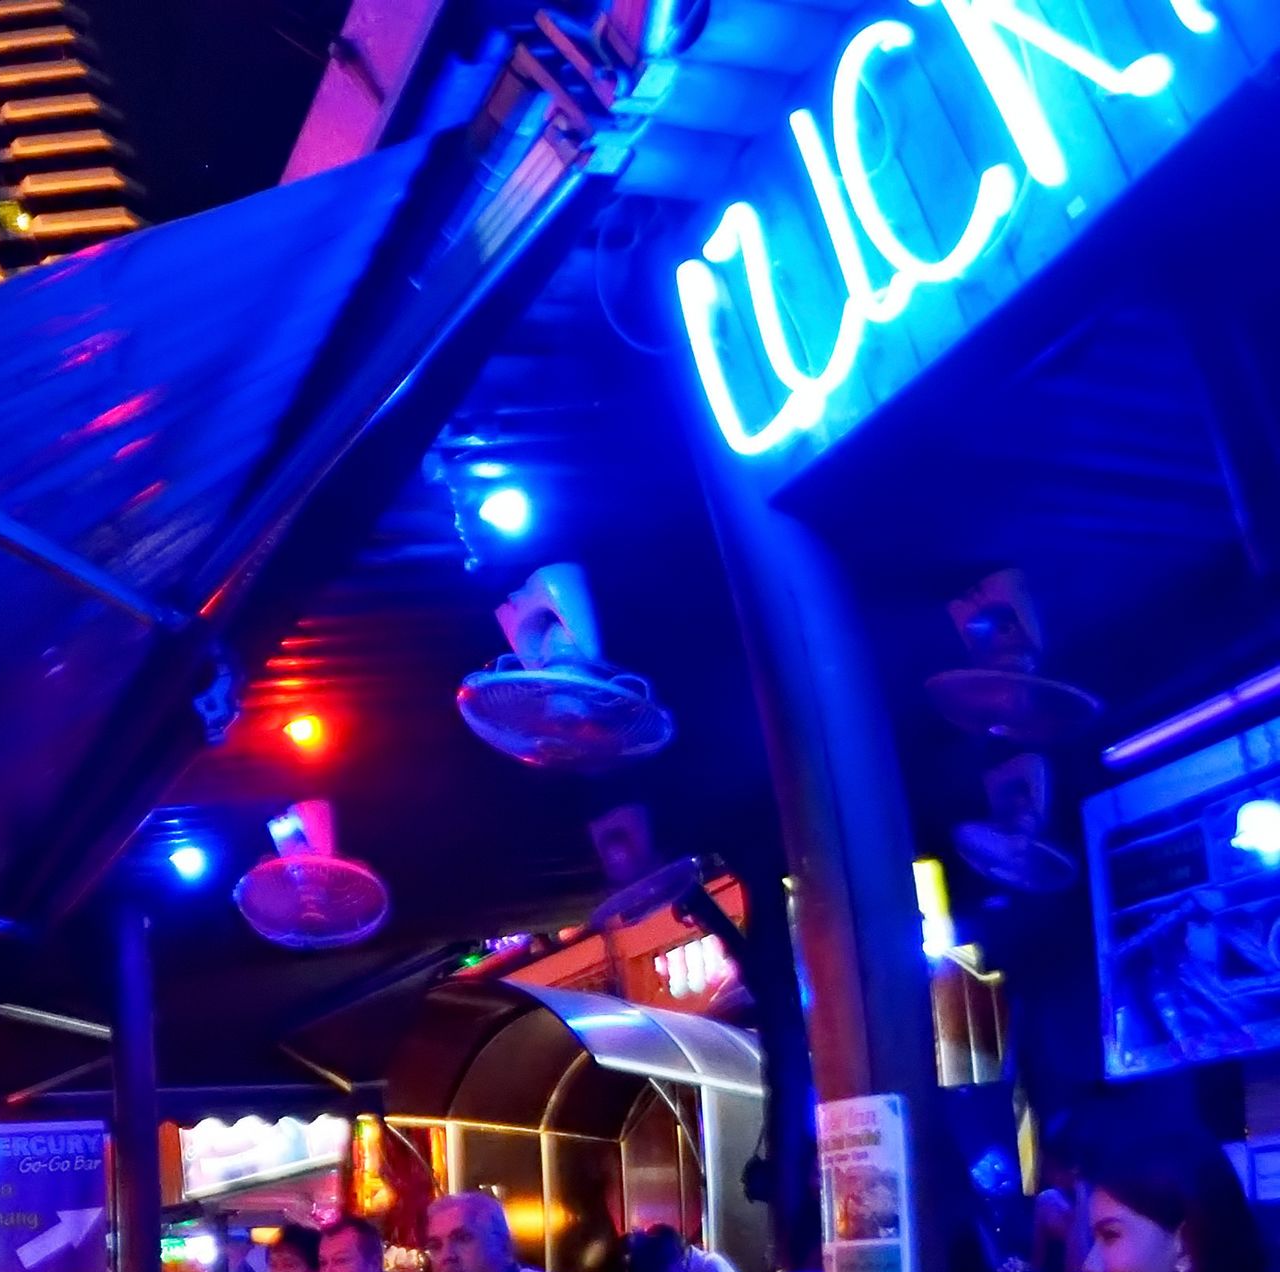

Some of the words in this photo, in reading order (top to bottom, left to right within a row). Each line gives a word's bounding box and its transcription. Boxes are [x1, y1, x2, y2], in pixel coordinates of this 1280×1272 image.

[676, 0, 1219, 457] LUCK
[18, 1155, 71, 1174] Go-Go
[73, 1154, 102, 1170] Bar
